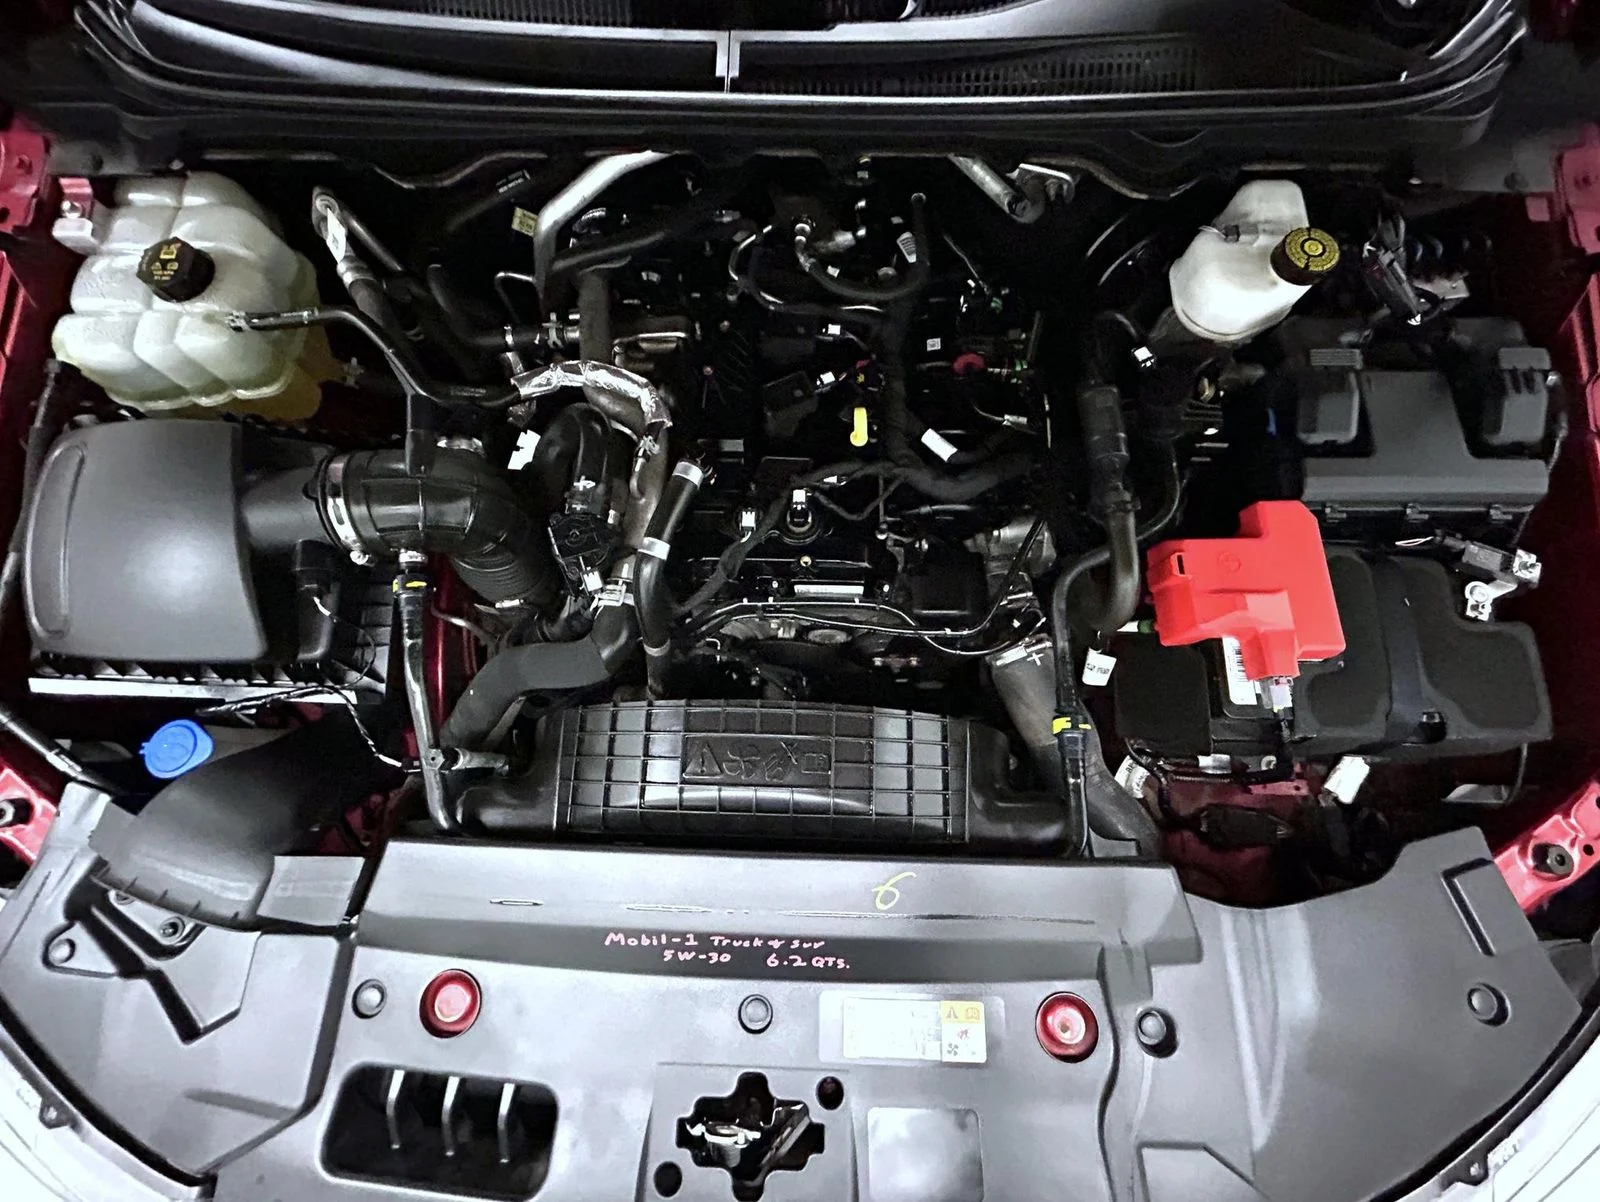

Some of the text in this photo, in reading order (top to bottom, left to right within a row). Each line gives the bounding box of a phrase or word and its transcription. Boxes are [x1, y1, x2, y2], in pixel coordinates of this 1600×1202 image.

[871, 871, 917, 910] 6
[604, 932, 698, 946] Mobil-1
[709, 935, 763, 947] Truck
[663, 949, 731, 964] 5W-30
[766, 953, 807, 967] 6.2
